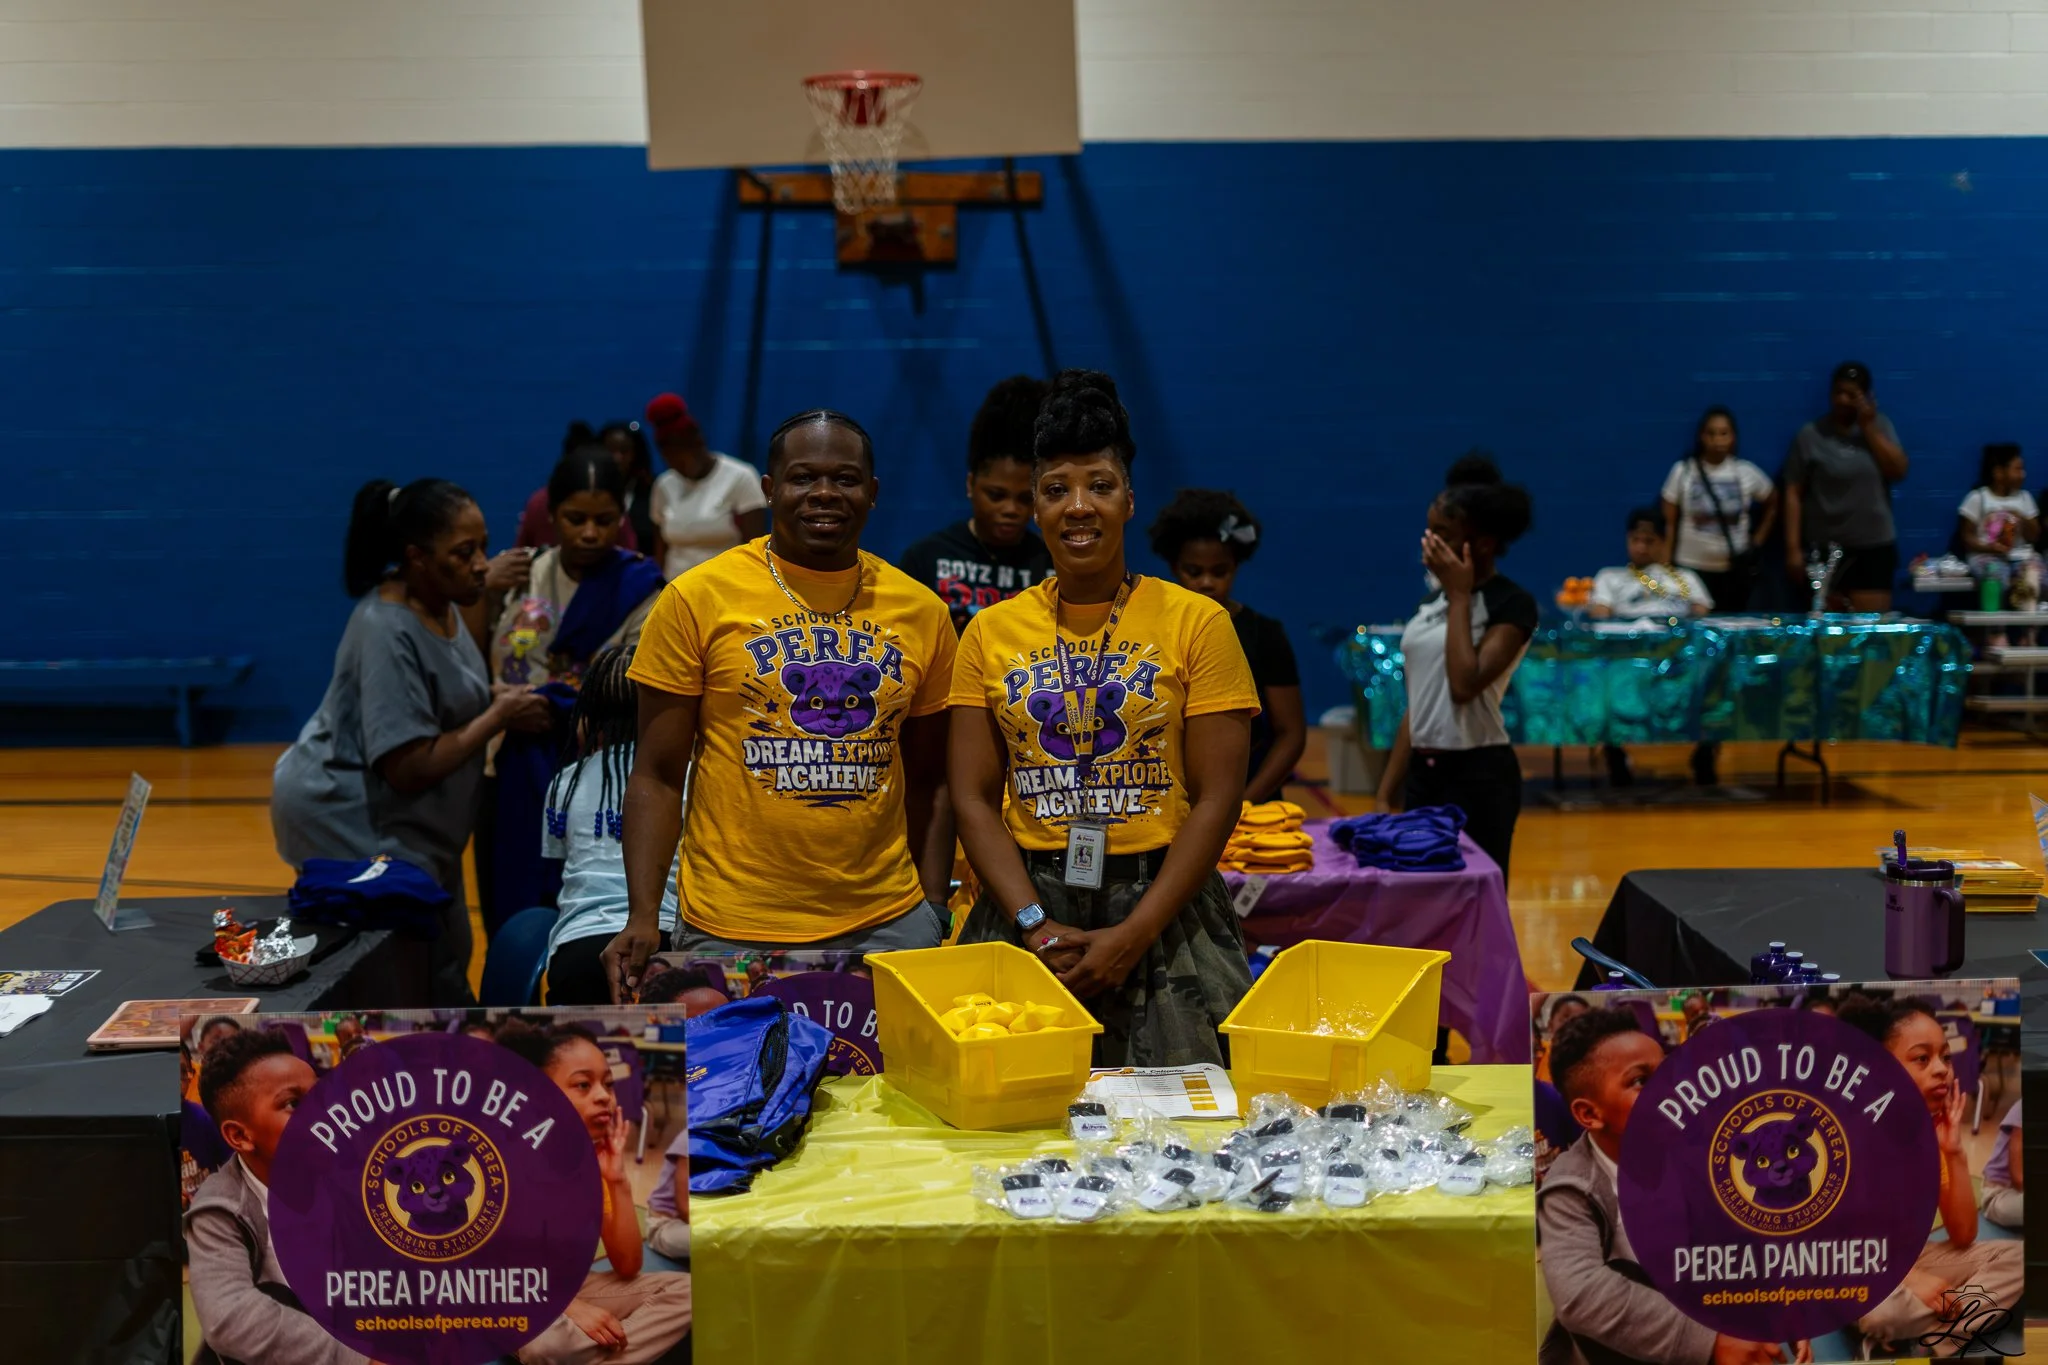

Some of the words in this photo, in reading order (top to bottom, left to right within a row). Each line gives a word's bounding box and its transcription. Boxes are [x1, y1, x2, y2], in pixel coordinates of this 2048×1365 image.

[771, 612, 853, 629] SCHOOLS
[862, 620, 882, 636] OF
[744, 626, 904, 684] PEREA
[1118, 640, 1142, 655] OF
[1003, 652, 1162, 706] PEREA
[1064, 672, 1070, 684] GO
[1068, 708, 1076, 732] SCHOOLS
[1082, 706, 1090, 730] SCHOOLS
[823, 1000, 853, 1028] TO
[860, 1009, 880, 1043] B
[829, 1041, 846, 1052] OF
[849, 1050, 871, 1074] PER
[1658, 1048, 1762, 1130] PROUD
[1778, 1044, 1815, 1081] TO
[1824, 1054, 1870, 1101] BE
[1864, 1090, 1896, 1123] A
[310, 1072, 416, 1154] PROUD
[434, 1068, 472, 1105] TO
[482, 1079, 528, 1128] BE
[522, 1117, 556, 1150] A
[1714, 1096, 1774, 1164] SCHOOLS
[1784, 1096, 1806, 1110] OF
[1810, 1108, 1844, 1160] PEREA
[368, 1121, 430, 1189] SCHOOLS
[438, 1121, 463, 1136] OF
[468, 1134, 502, 1188] PEREA
[1724, 1178, 1780, 1224] PREPARING
[1787, 1173, 1838, 1222] STUDENTS
[376, 1203, 437, 1250] PREPARING
[444, 1200, 494, 1250] STUDENTS
[1674, 1244, 1757, 1282] PEREA
[1765, 1238, 1888, 1278] PANTHER!
[326, 1270, 412, 1307] PEREA
[420, 1267, 548, 1305] PANTHER!
[1703, 1286, 1869, 1306] schoolsofperea.org
[355, 1314, 528, 1334] schoolsofperea.org
